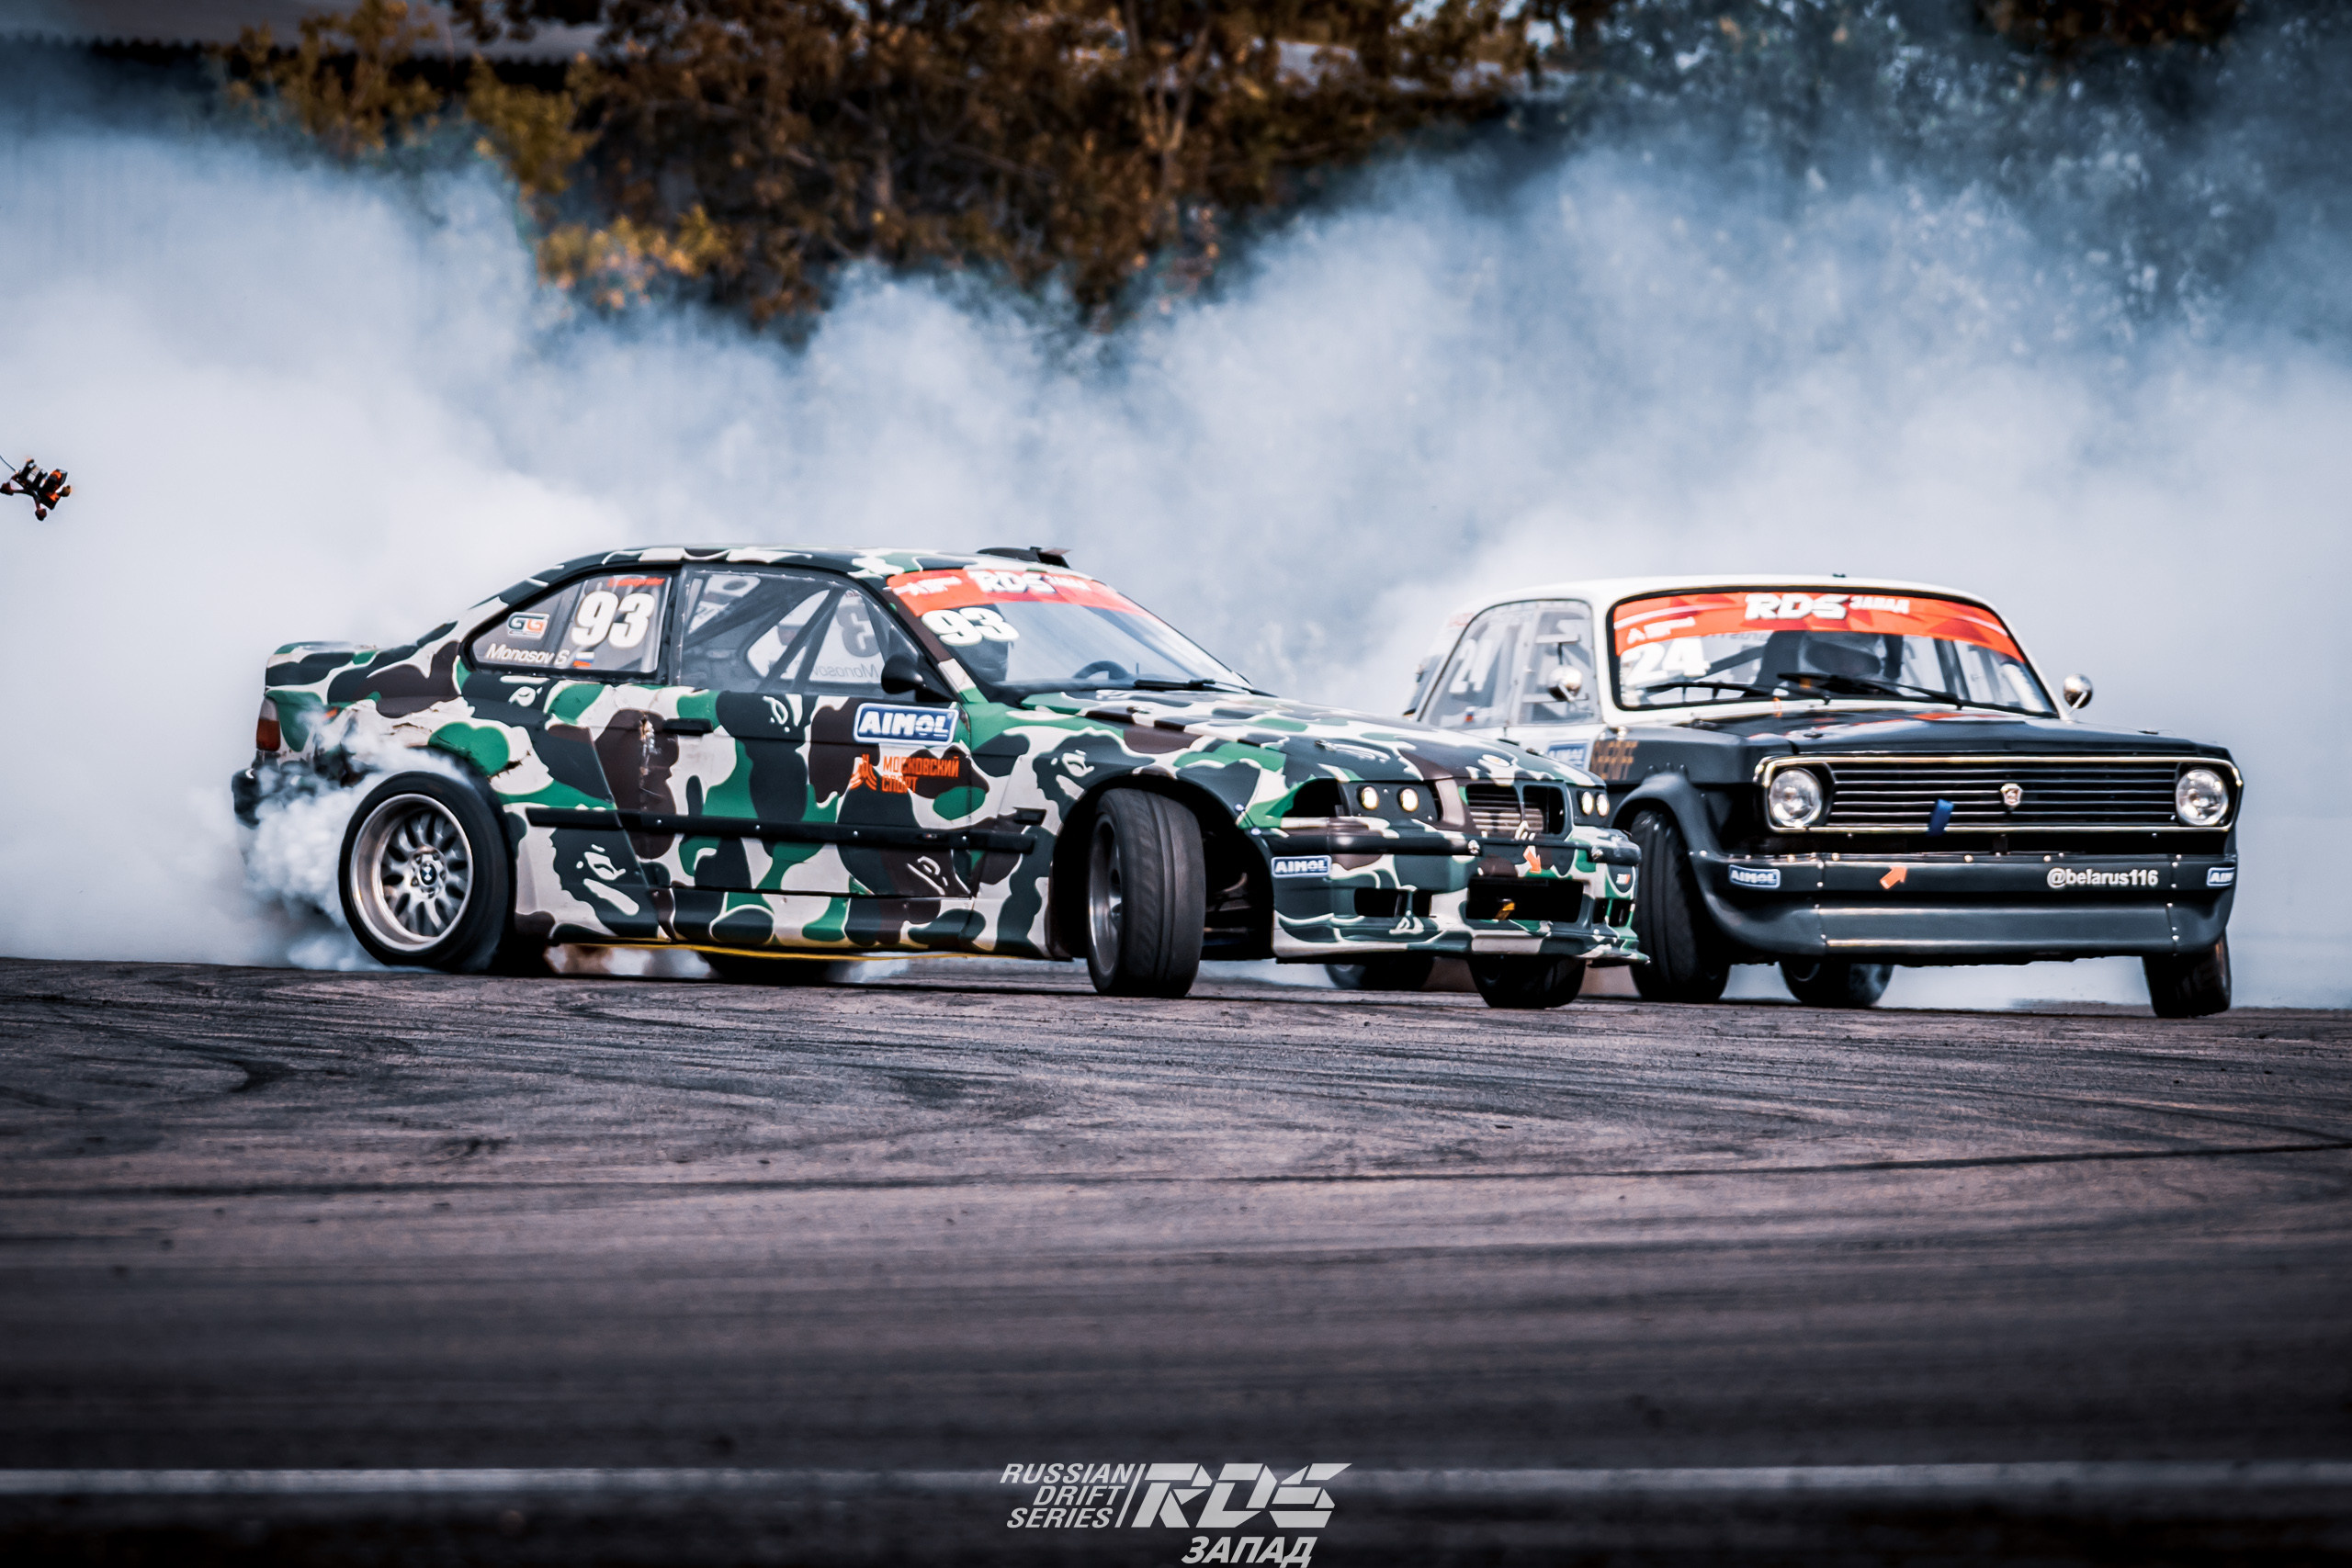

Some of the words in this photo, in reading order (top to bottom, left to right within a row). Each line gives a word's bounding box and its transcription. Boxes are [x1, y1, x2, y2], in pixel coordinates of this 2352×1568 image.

[967, 570, 1057, 594] RDS
[1745, 592, 1850, 620] RDS
[571, 591, 656, 649] 93
[921, 607, 1020, 647] 93
[486, 643, 553, 664] Monosov
[554, 649, 570, 665] S
[1620, 637, 1711, 686] 24
[858, 711, 949, 738] AIMOL
[883, 755, 959, 778] МОСКОВСКИЙ
[881, 774, 918, 794] СПОРТ
[1275, 860, 1328, 873] AIMOL
[2046, 867, 2159, 888] @belarus116
